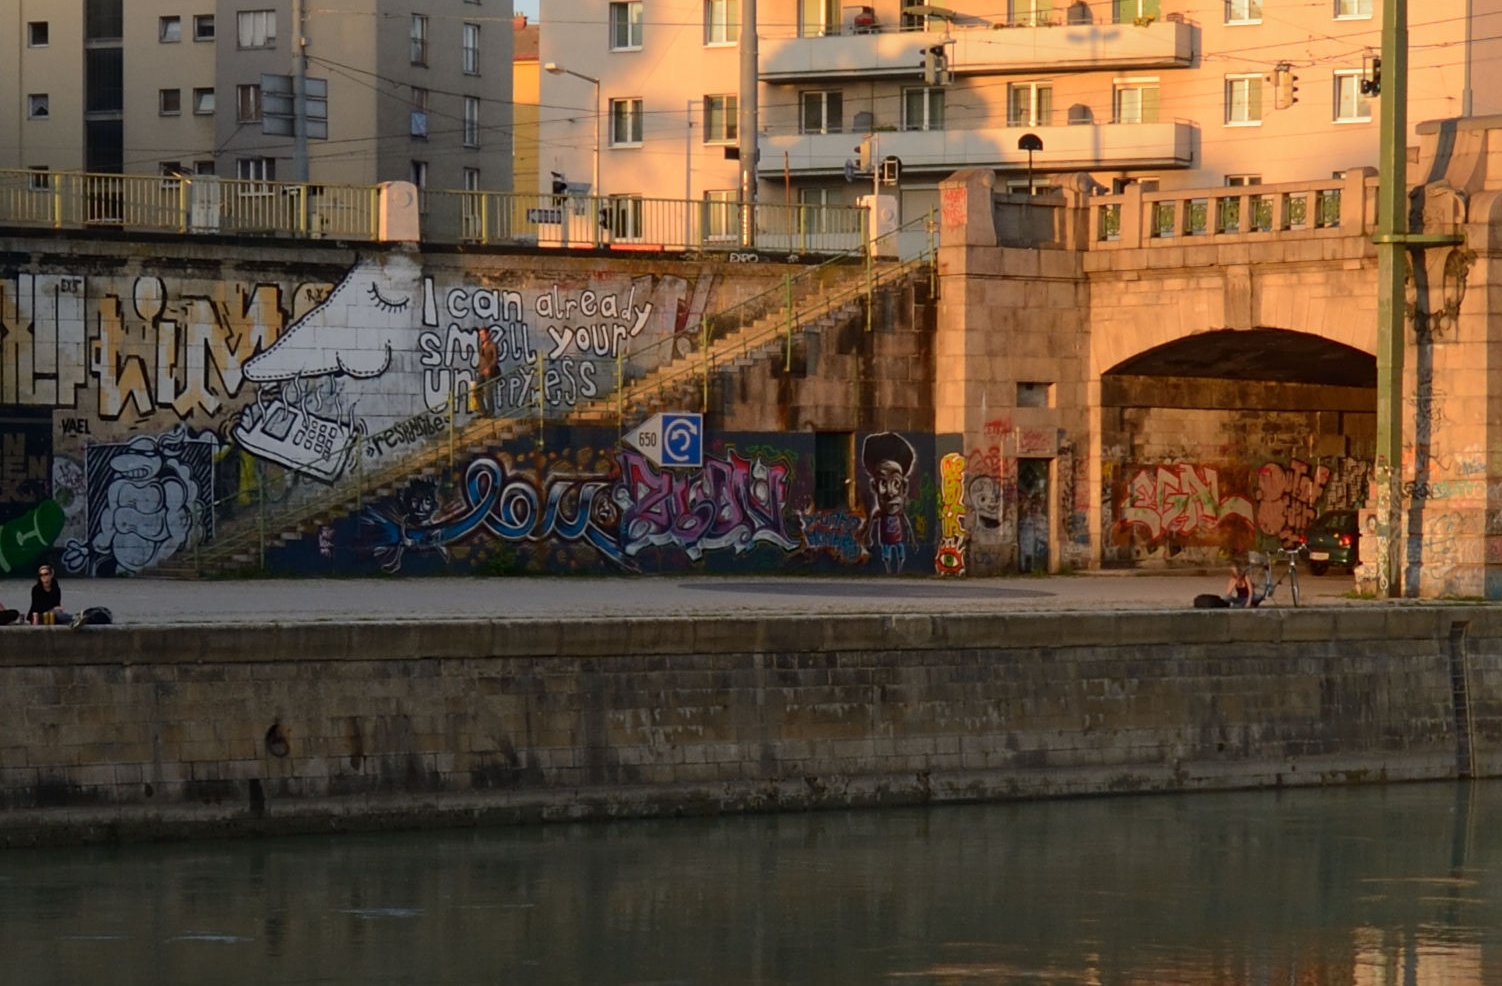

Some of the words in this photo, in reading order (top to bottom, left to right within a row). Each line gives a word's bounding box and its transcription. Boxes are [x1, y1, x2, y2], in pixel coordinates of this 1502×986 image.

[423, 275, 439, 327] I
[447, 288, 523, 322] can
[535, 283, 653, 337] already
[419, 322, 538, 367] smell
[547, 323, 628, 359] your
[638, 431, 657, 448] 650
